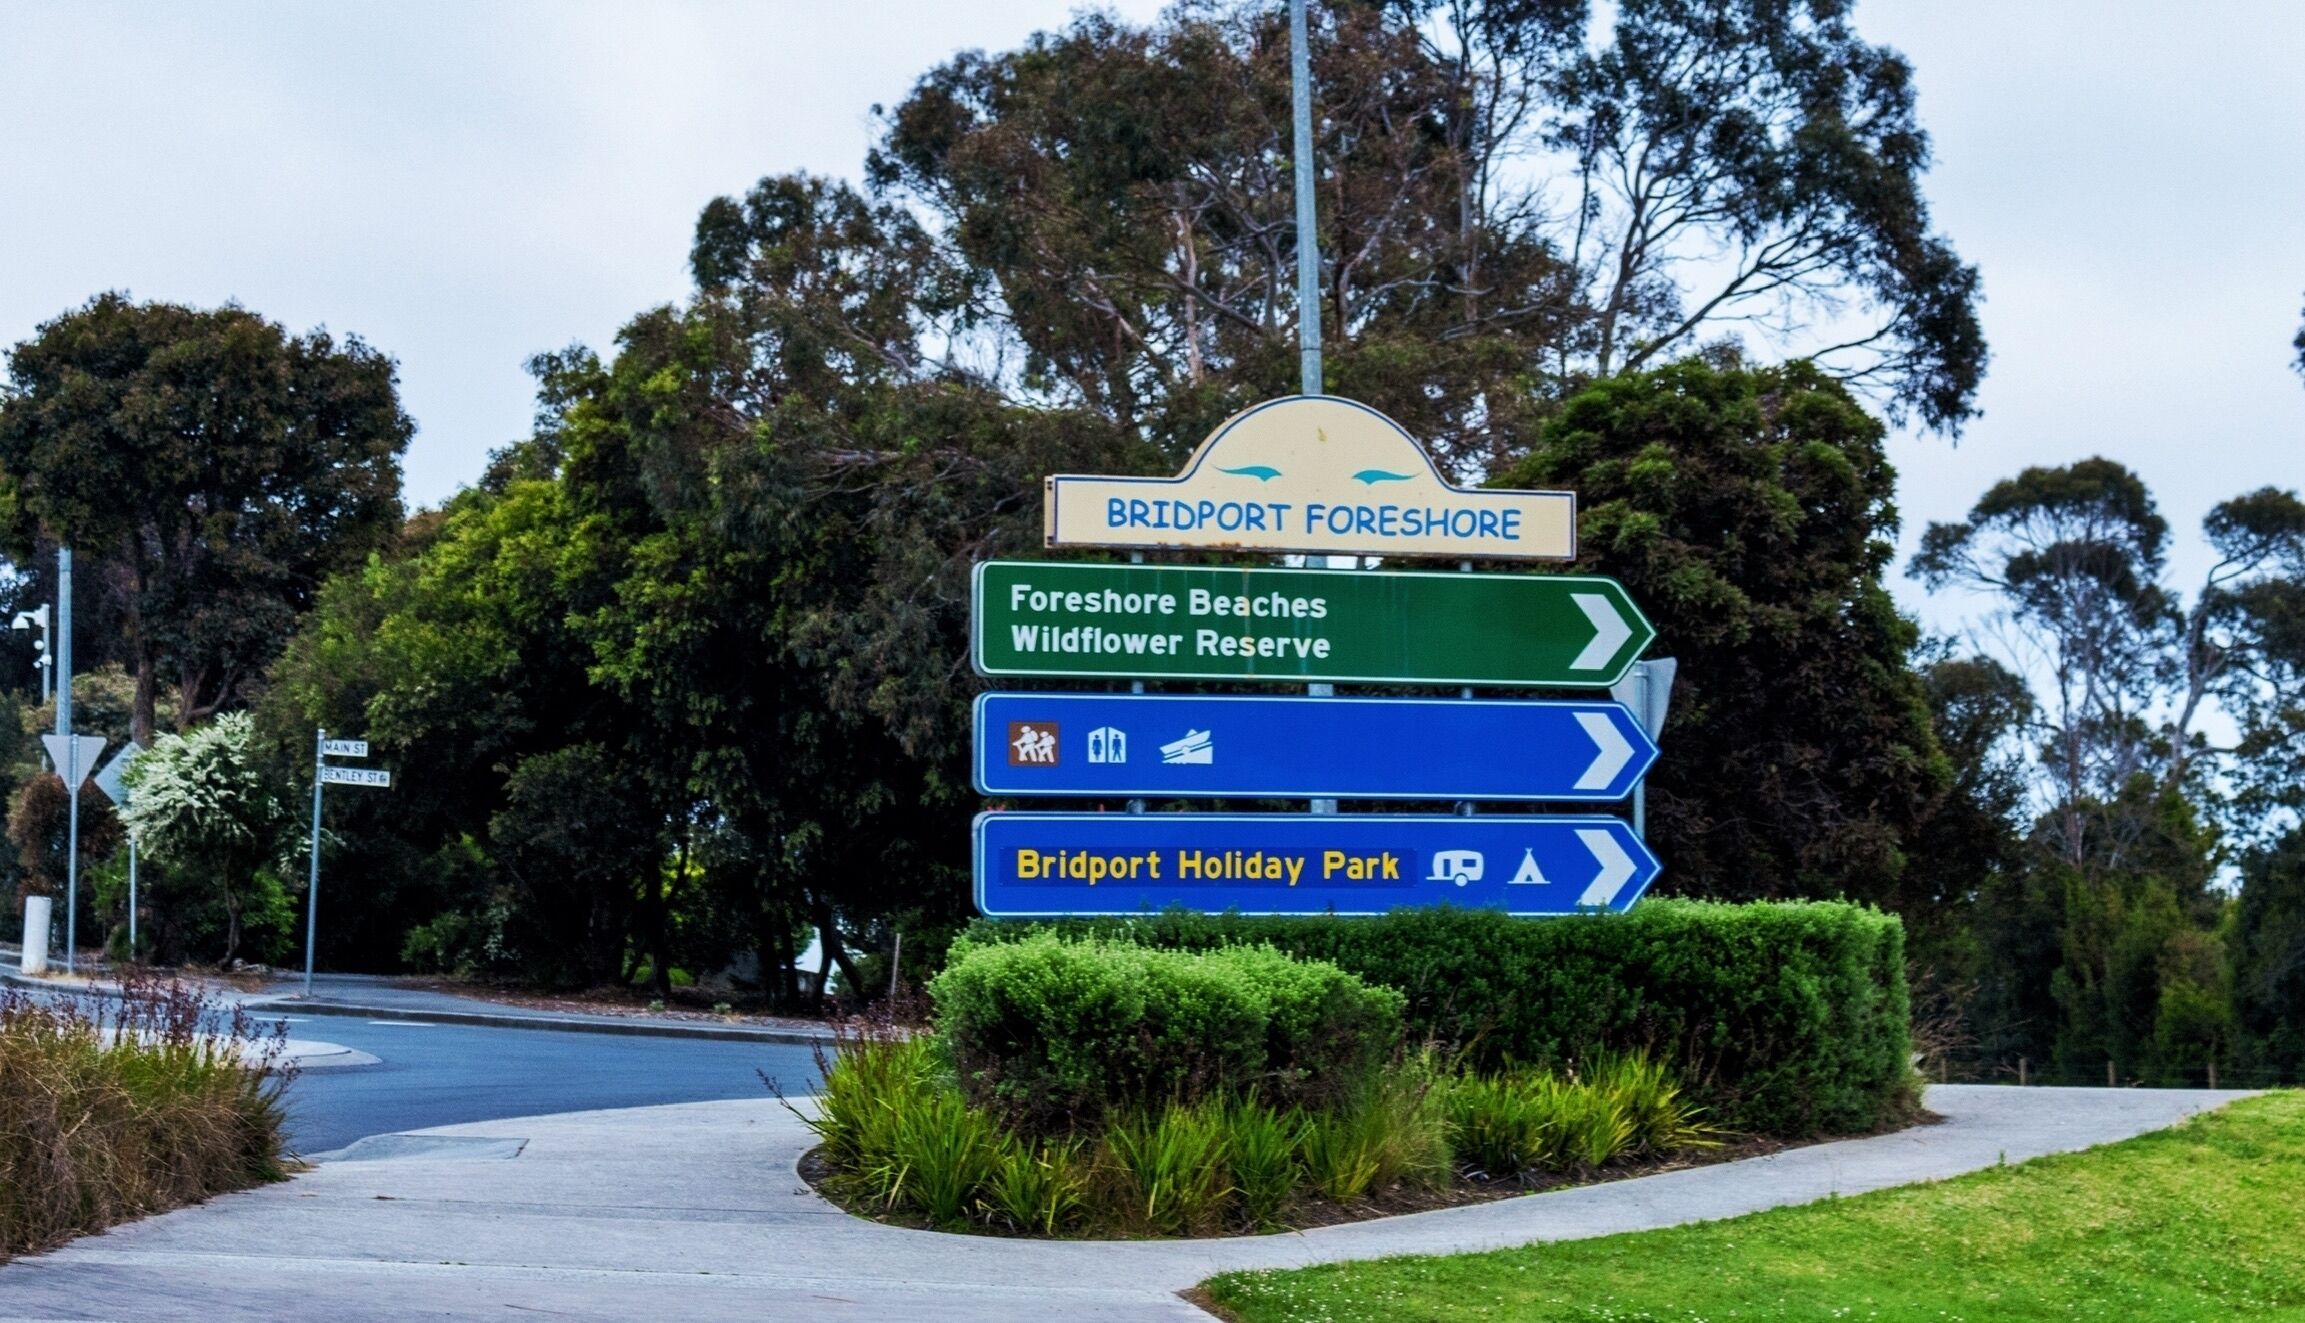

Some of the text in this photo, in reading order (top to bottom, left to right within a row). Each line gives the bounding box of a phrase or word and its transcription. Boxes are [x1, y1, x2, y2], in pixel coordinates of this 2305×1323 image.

[1106, 496, 1522, 540] BRIDPORT FORESHORE
[1010, 584, 1328, 619] Foreshore Beaches
[1011, 624, 1331, 659] Wildflower Reserve
[325, 743, 365, 754] MAIN ST
[324, 769, 378, 783] BENTLEY ST
[1016, 848, 1401, 886] Bridport Holiday Park
